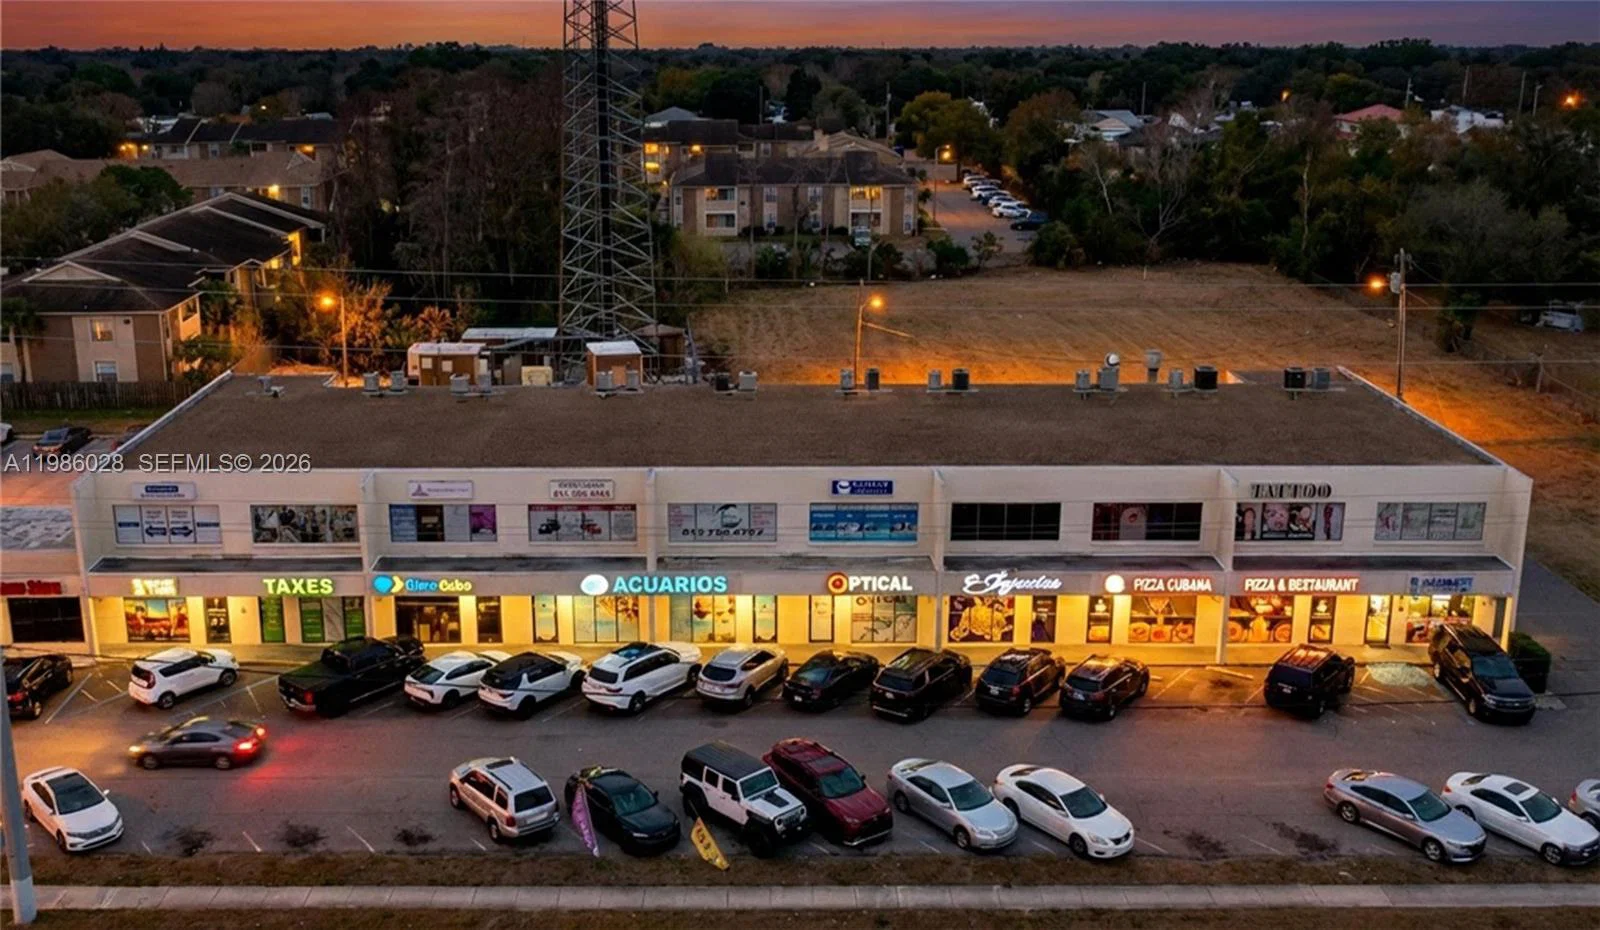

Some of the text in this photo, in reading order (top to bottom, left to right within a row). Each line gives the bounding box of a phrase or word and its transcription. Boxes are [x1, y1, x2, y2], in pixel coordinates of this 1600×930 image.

[263, 578, 334, 594] TAXES
[612, 576, 728, 593] ACUARIOS
[1133, 578, 1212, 592] PIZZA CUBANA
[1244, 578, 1276, 592] PIZZA
